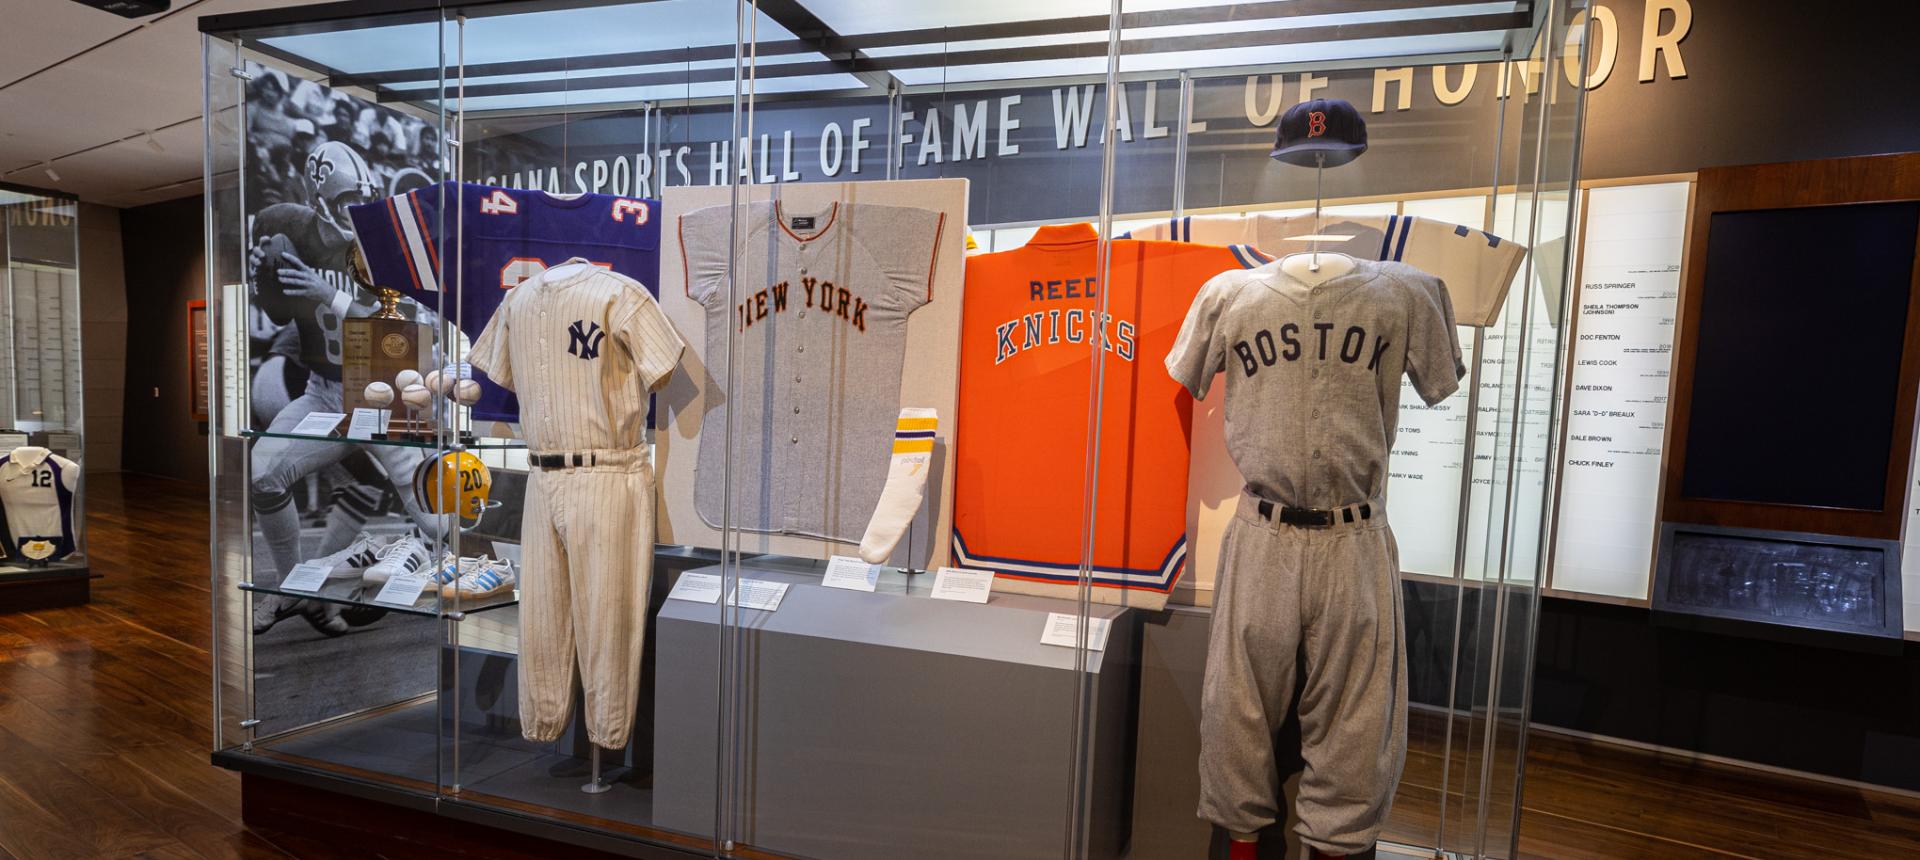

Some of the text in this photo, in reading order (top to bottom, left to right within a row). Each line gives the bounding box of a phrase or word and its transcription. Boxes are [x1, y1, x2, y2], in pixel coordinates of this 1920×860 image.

[709, 130, 799, 186] HALL
[820, 118, 871, 177] OF
[898, 94, 1021, 168] FAME
[1051, 81, 1207, 150] WALL
[1308, 111, 1327, 138] B
[801, 277, 868, 332] YORK
[567, 319, 606, 361] NY
[995, 308, 1136, 366] KNICKS
[1588, 435, 1612, 443] BROWN
[1591, 460, 1614, 468] FINLEY
[31, 469, 52, 488] 12
[459, 468, 483, 493] 20
